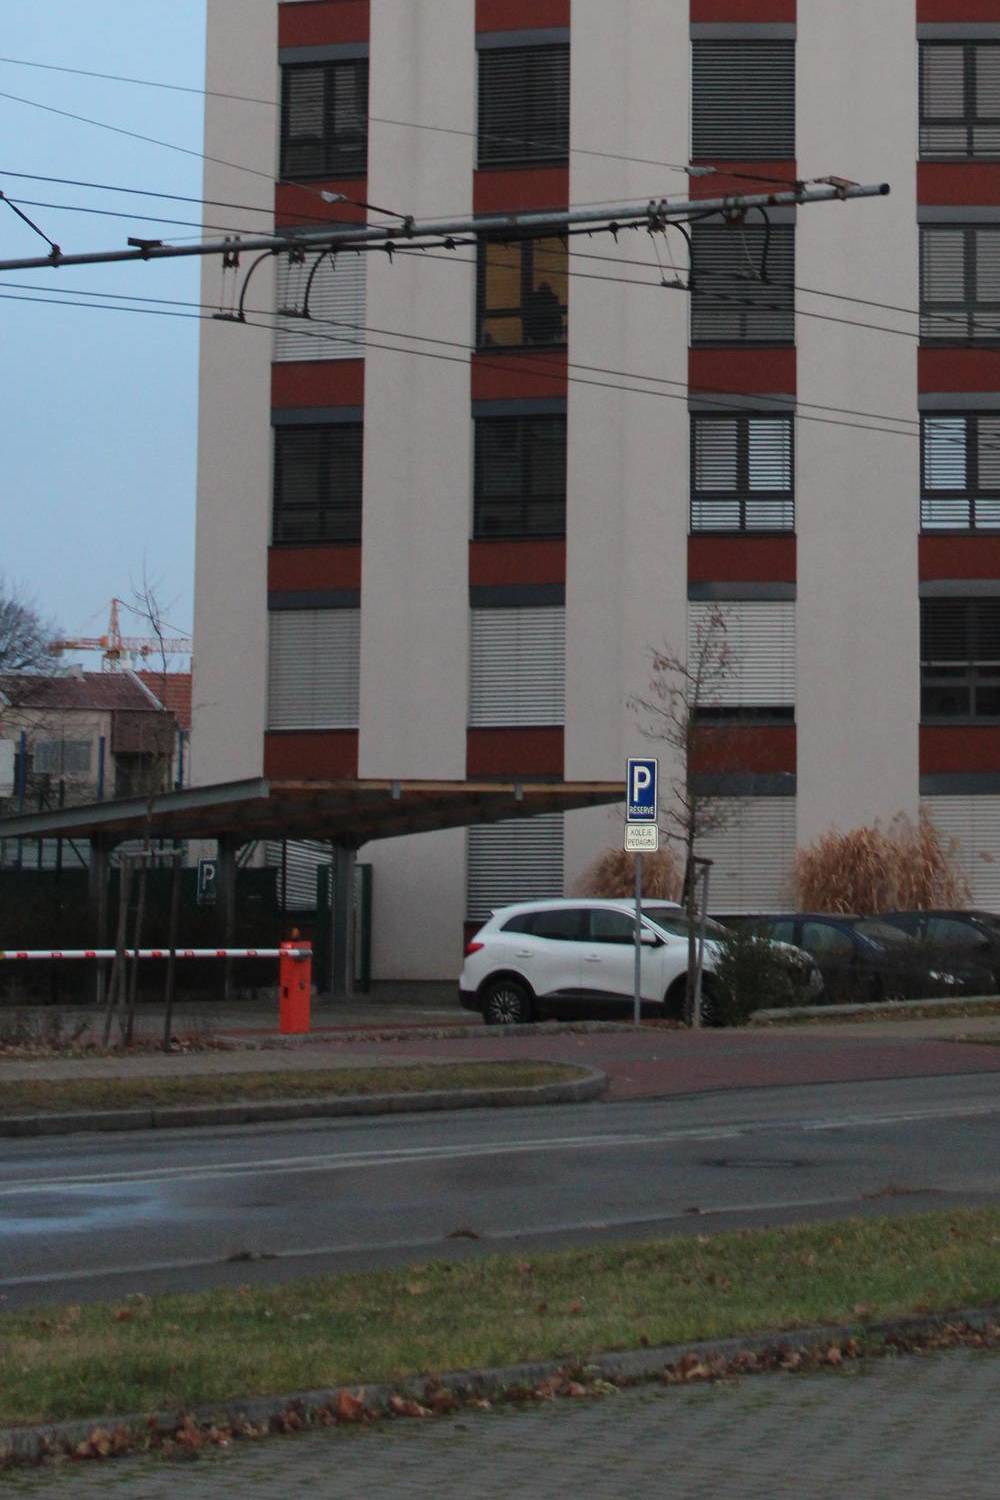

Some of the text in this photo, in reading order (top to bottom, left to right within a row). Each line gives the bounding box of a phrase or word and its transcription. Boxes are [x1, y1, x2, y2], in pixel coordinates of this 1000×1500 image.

[633, 766, 651, 802] P
[627, 838, 655, 846] PEDAGOG
[202, 863, 215, 890] P
